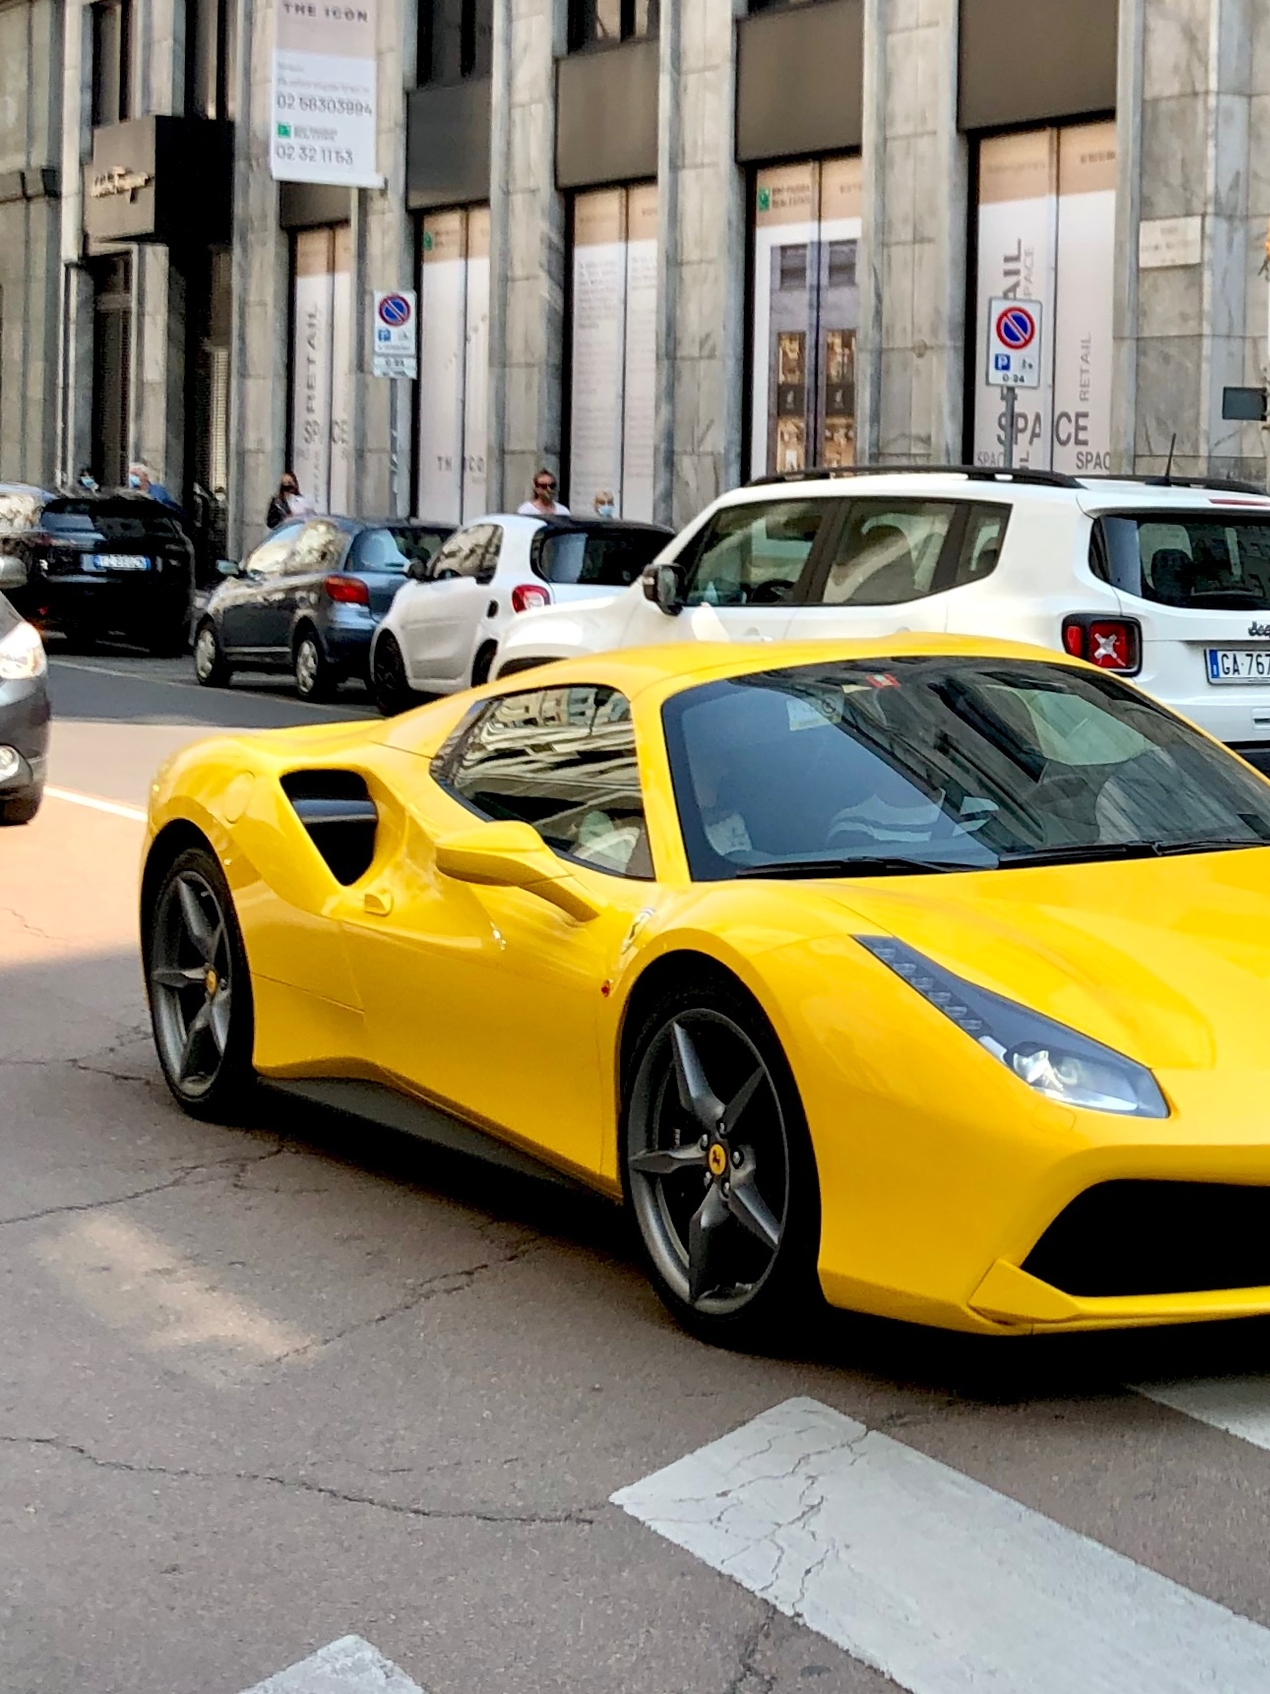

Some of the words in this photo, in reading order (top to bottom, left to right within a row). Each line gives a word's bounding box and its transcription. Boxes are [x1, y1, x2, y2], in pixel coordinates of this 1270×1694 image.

[283, 3, 317, 17] THE
[325, 8, 368, 22] ICON
[276, 92, 295, 110] 02
[276, 143, 296, 161] 02
[1079, 332, 1092, 402] RETAIL
